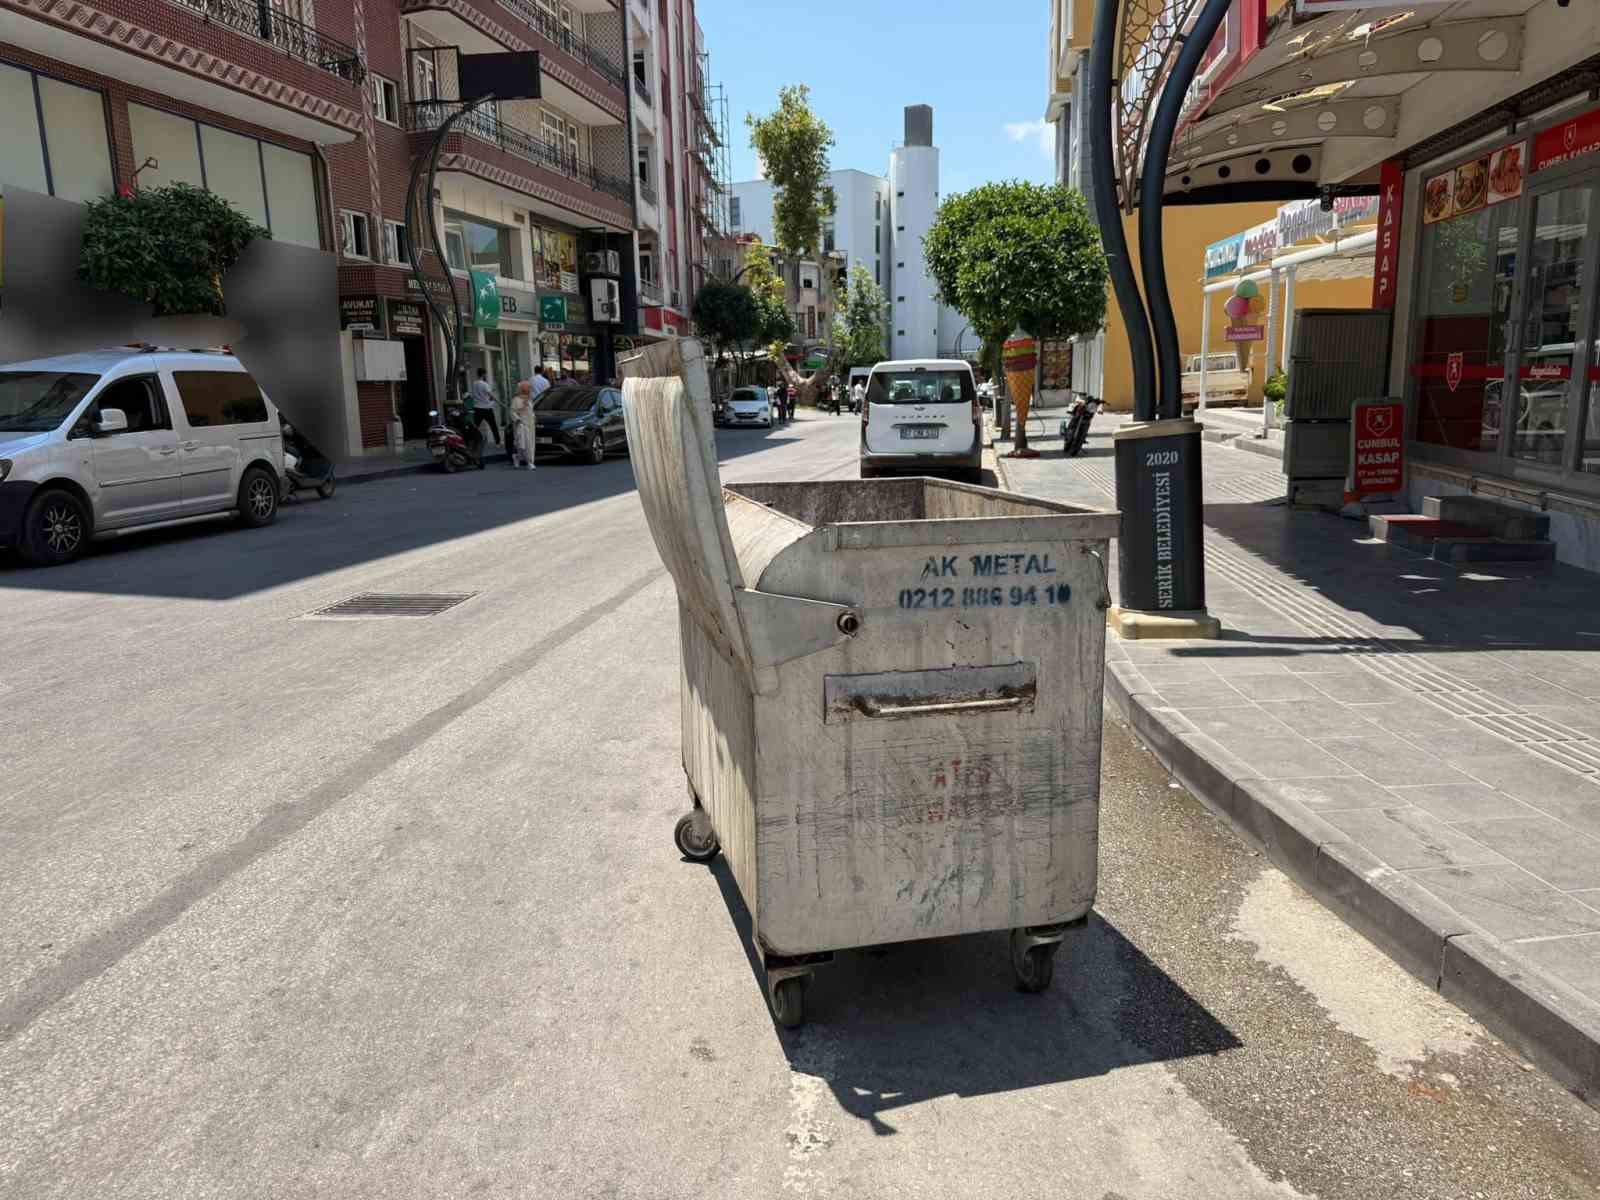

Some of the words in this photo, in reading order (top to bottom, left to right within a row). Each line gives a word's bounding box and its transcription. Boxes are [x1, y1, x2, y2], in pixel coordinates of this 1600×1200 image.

[1379, 184, 1394, 296] KASAP
[1146, 451, 1178, 466] 2020
[1358, 452, 1400, 465] KASAP
[1152, 471, 1172, 561] BELEDİYESİ
[923, 556, 958, 578] AK
[970, 554, 1057, 577] METAL
[899, 587, 955, 609] 0212
[1010, 586, 1037, 606] 94
[1155, 564, 1173, 608] SERİK
